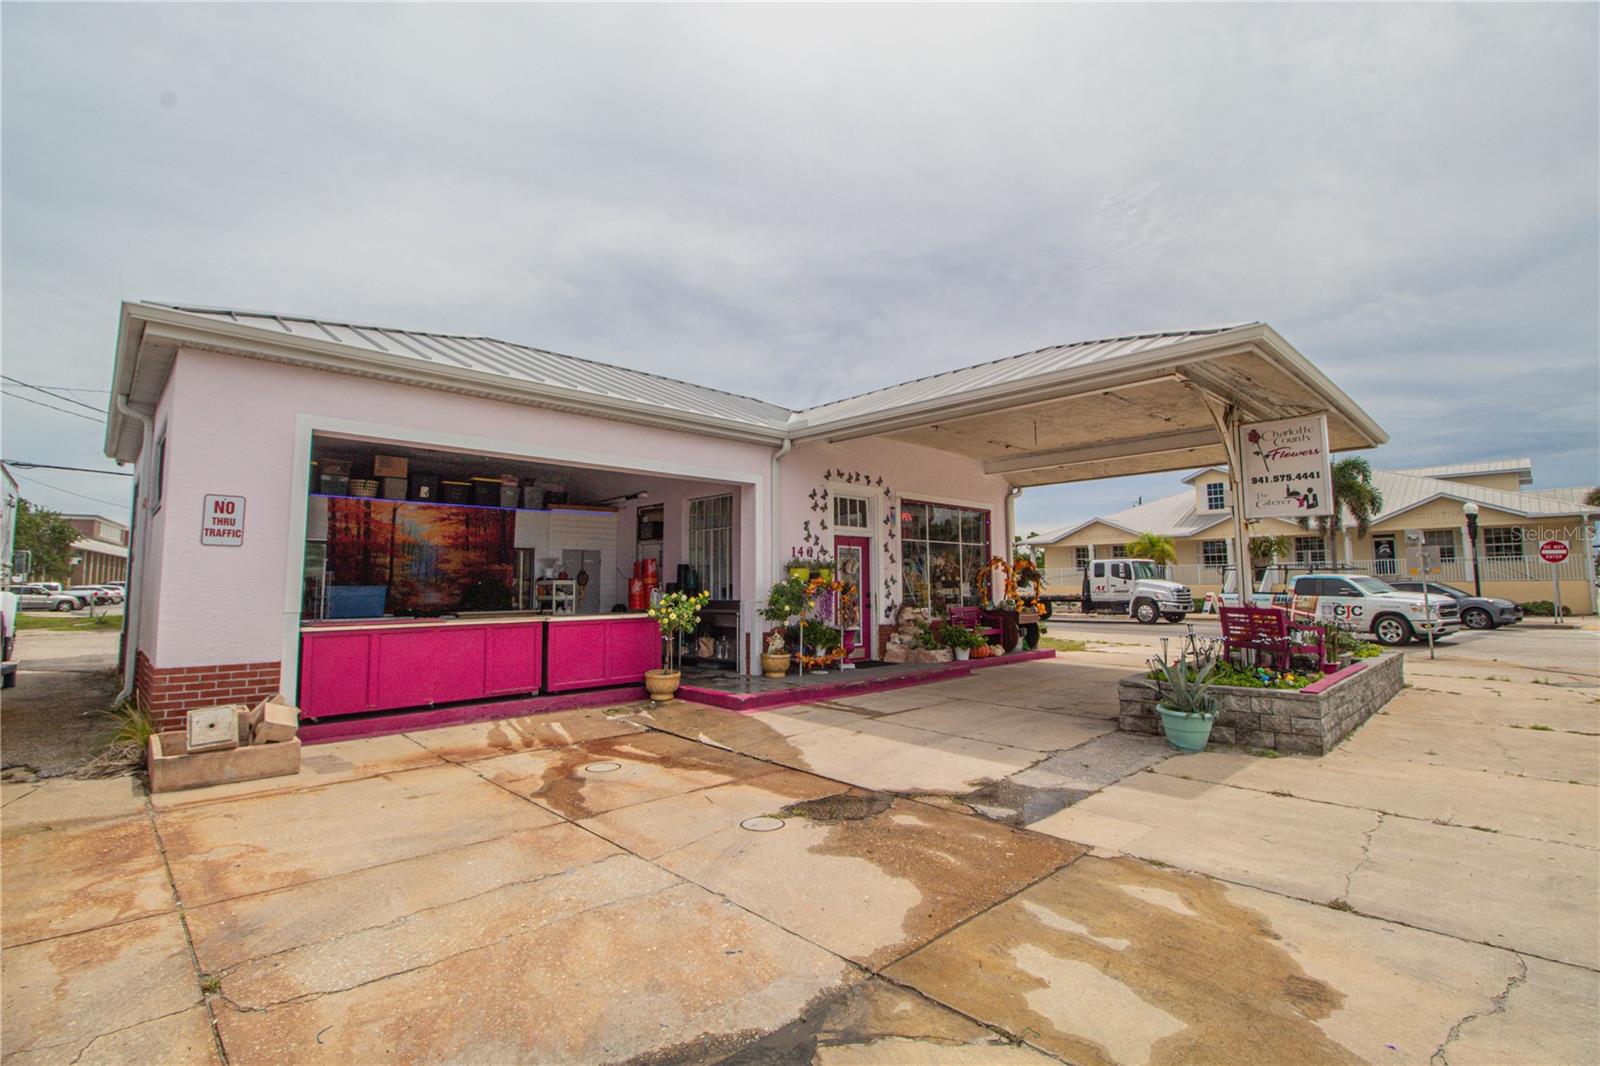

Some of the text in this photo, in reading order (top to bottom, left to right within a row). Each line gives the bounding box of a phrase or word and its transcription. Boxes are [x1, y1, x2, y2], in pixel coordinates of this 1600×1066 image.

[1273, 434, 1311, 447] County
[1268, 447, 1322, 460] Flowers
[1251, 471, 1320, 485] 941.575.4441
[214, 500, 235, 514] NO
[212, 516, 236, 526] THRU
[204, 528, 242, 538] TRAFFIC
[1333, 605, 1363, 620] GJC
